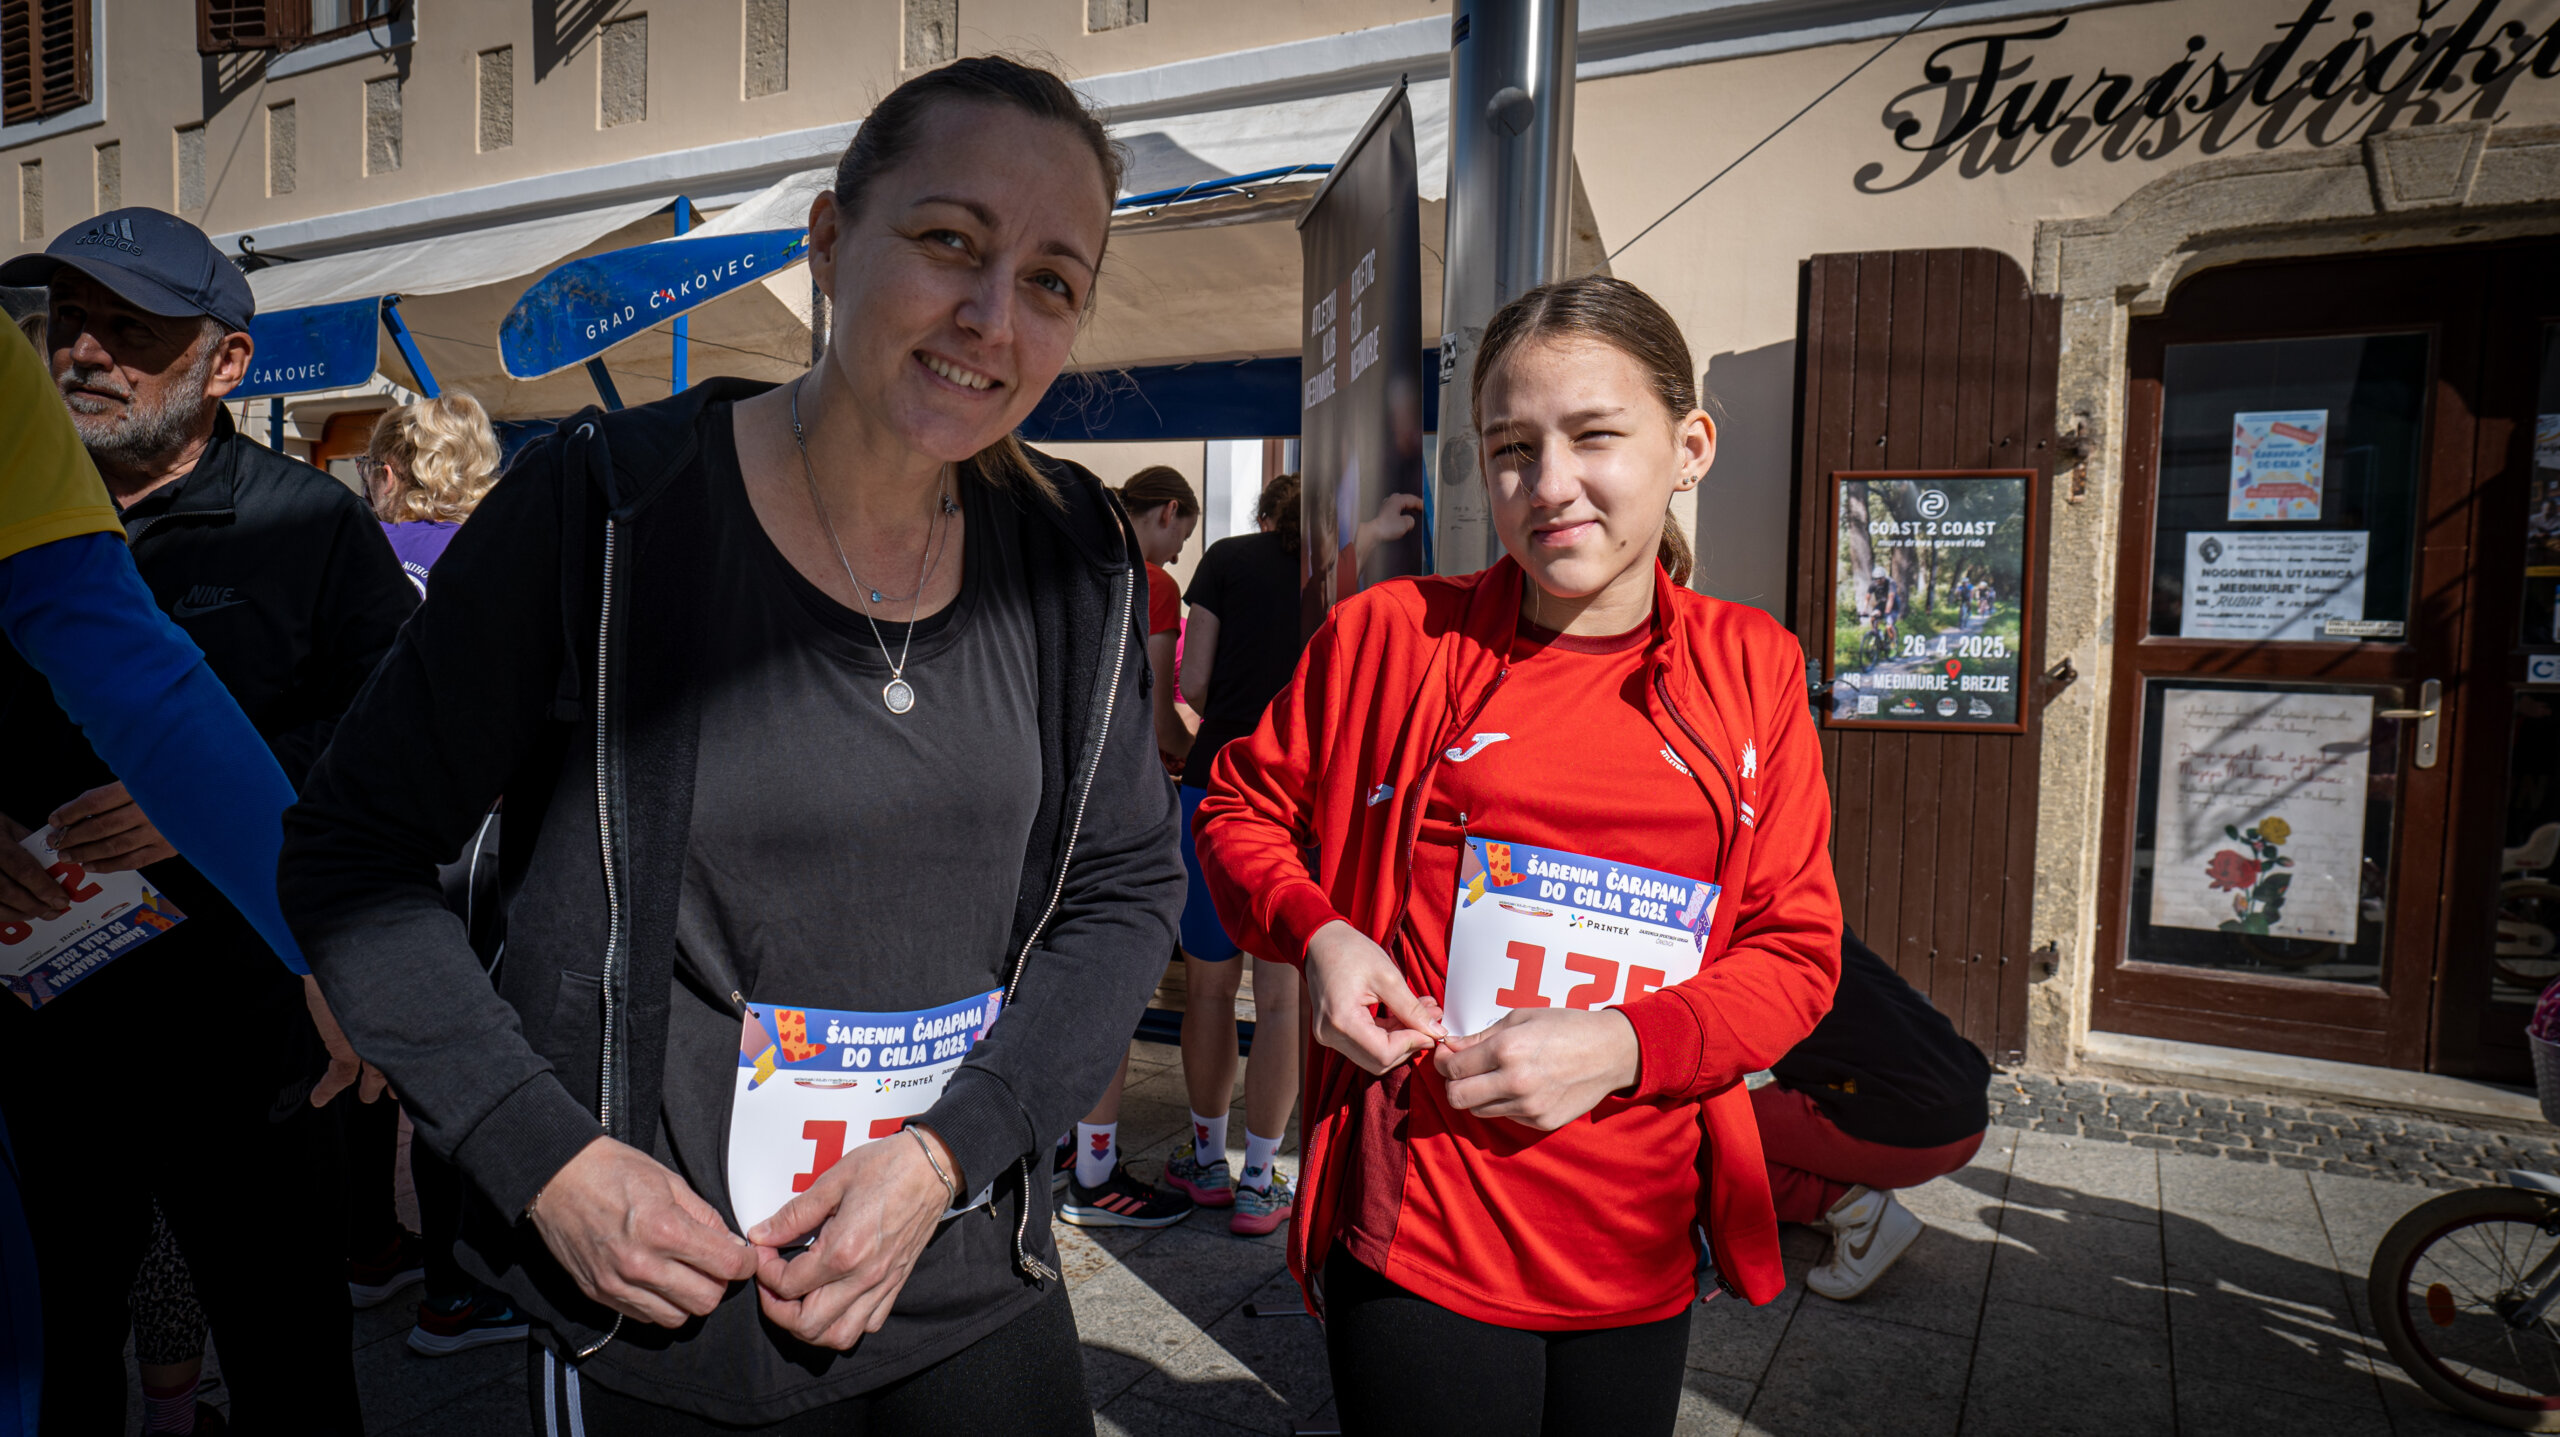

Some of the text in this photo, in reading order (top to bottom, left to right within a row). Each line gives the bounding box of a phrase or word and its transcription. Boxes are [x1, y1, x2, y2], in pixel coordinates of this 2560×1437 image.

[76, 232, 143, 256] adidas
[586, 253, 755, 340] GRAD ČAKOVEC
[253, 362, 325, 384] ČAKOVEC
[1869, 521, 1996, 536] COAST 2 COAST
[1933, 538, 1965, 549] gravel
[1966, 538, 1986, 548] ride
[2201, 568, 2355, 580] NOGOMETNA UTAKMICA
[185, 584, 235, 604] NIKE
[1903, 634, 2012, 659] 26. 4. 2025.
[1873, 673, 1950, 691] MEĐIMURJE
[1960, 675, 2010, 692] BREZJE
[1660, 749, 1689, 775] ATLETSKI
[1526, 854, 1687, 906] ŠARENIM ČARAPAMA
[1539, 880, 1567, 901] DO
[1573, 883, 1622, 913] CILJA
[1629, 897, 1668, 924] 2025.
[78, 929, 112, 951] CILJA
[105, 926, 150, 952] ŠARENIM
[108, 920, 128, 936] DO
[48, 948, 83, 971] 2025.
[48, 949, 112, 988] ČARAPAMA
[826, 1006, 982, 1045] ŠARENIM ČARAPAMA
[841, 1032, 967, 1068] DO CILJA 2025.
